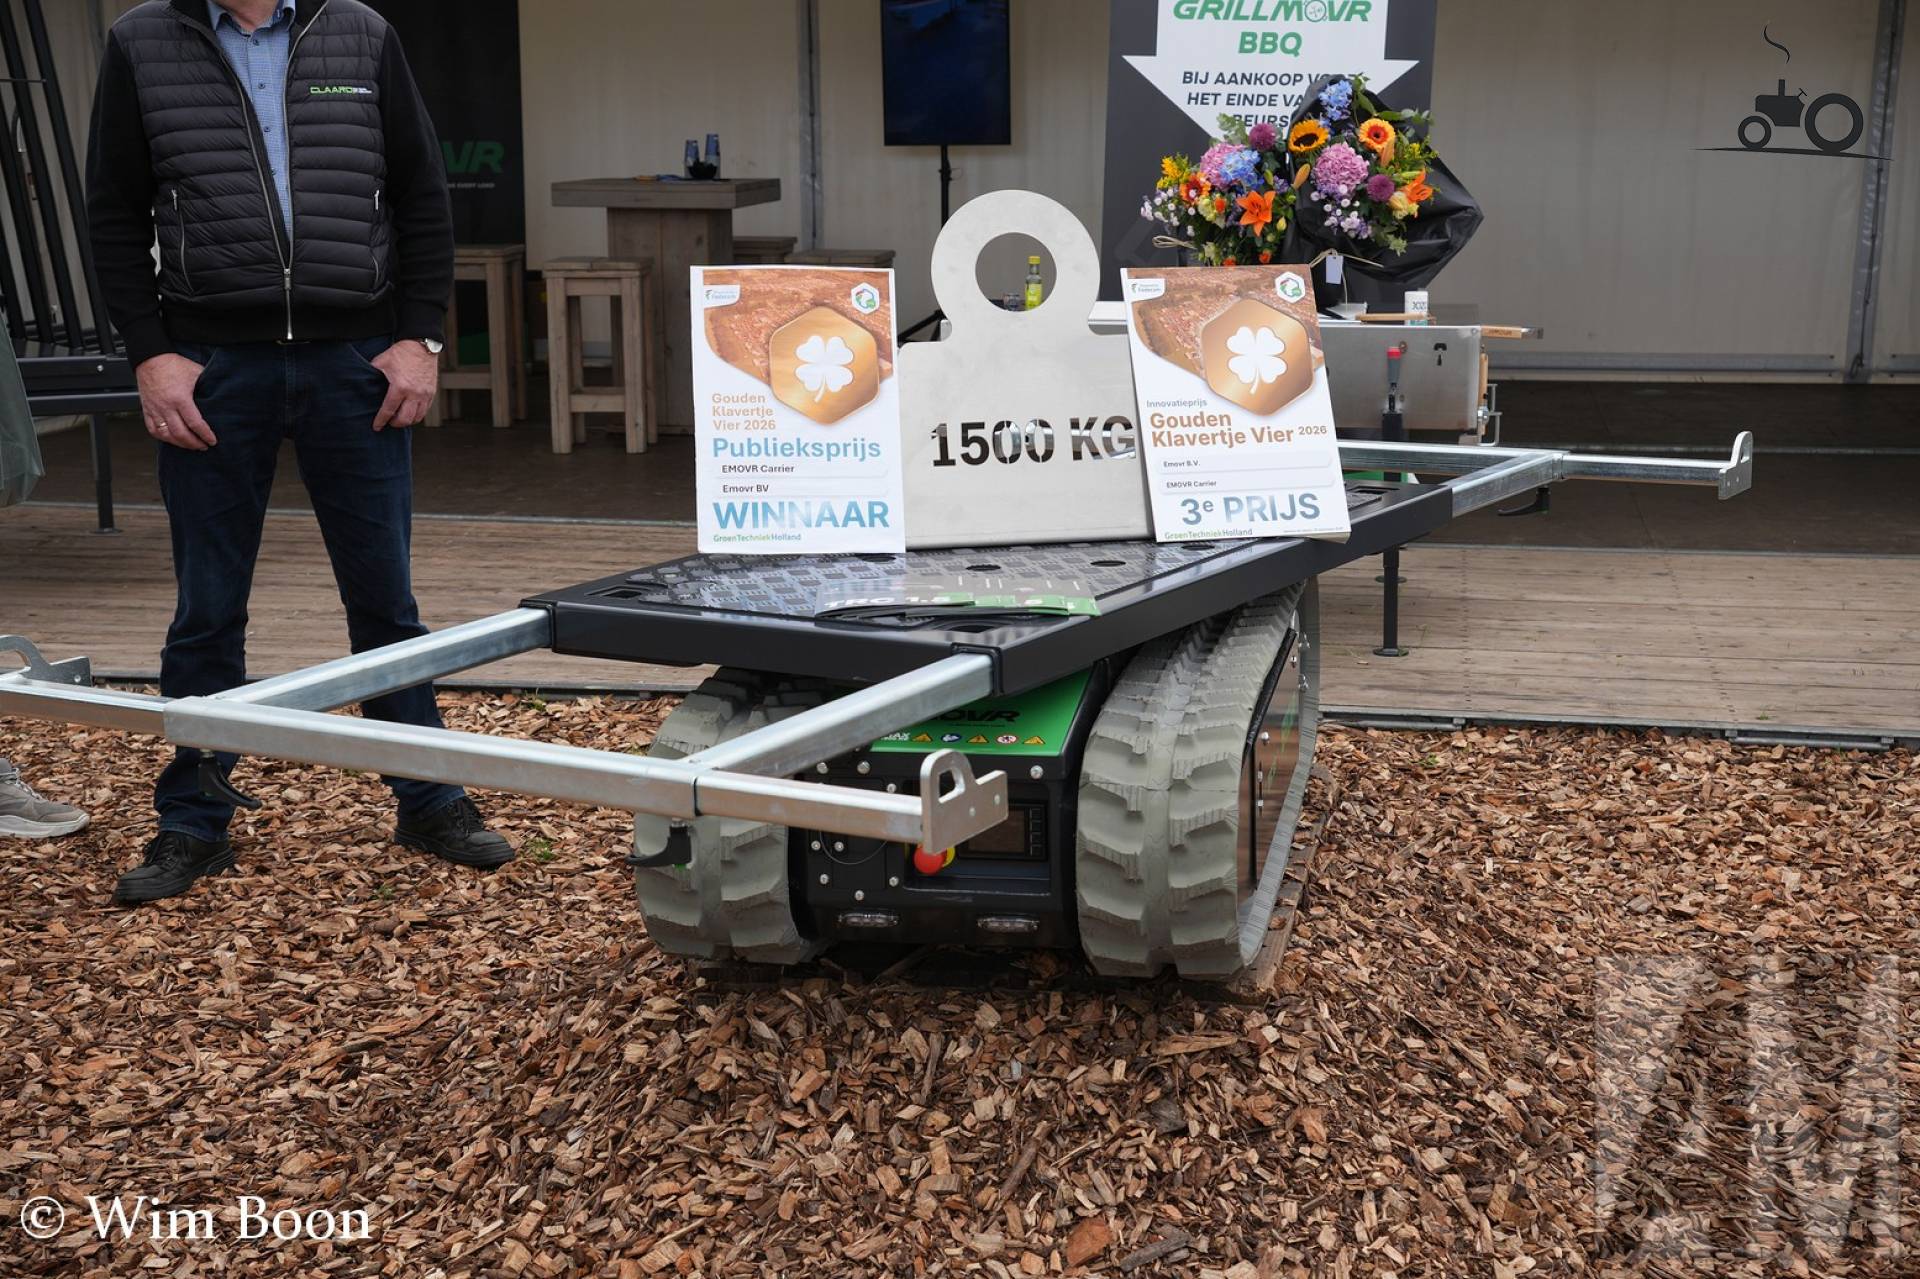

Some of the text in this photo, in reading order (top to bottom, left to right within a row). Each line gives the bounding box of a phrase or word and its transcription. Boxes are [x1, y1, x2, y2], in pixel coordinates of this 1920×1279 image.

[1238, 31, 1302, 57] BBQ
[1182, 71, 1209, 85] BIJ
[1214, 73, 1303, 86] AANKOOP
[1187, 92, 1304, 107] HET EINDE VA
[712, 393, 766, 404] Gouden
[1146, 398, 1207, 408] Innovatieprijs
[712, 405, 773, 418] Klavertje
[713, 420, 776, 431] Vier 2026
[1150, 411, 1232, 430] Gouden
[931, 416, 1136, 467] 1500 KG
[1151, 425, 1327, 449] Klavertje Vier 2026
[713, 437, 881, 462] Publieksprijs
[722, 464, 795, 473] EMOVR Carrier
[722, 484, 769, 493] Emovr BV
[1193, 479, 1217, 488] Carrier
[713, 501, 889, 529] WINNAAR
[1180, 493, 1320, 526] 3e PRIJS
[713, 533, 801, 543] GroenTechniekHolland
[1164, 528, 1253, 540] GroenTechniekHolland
